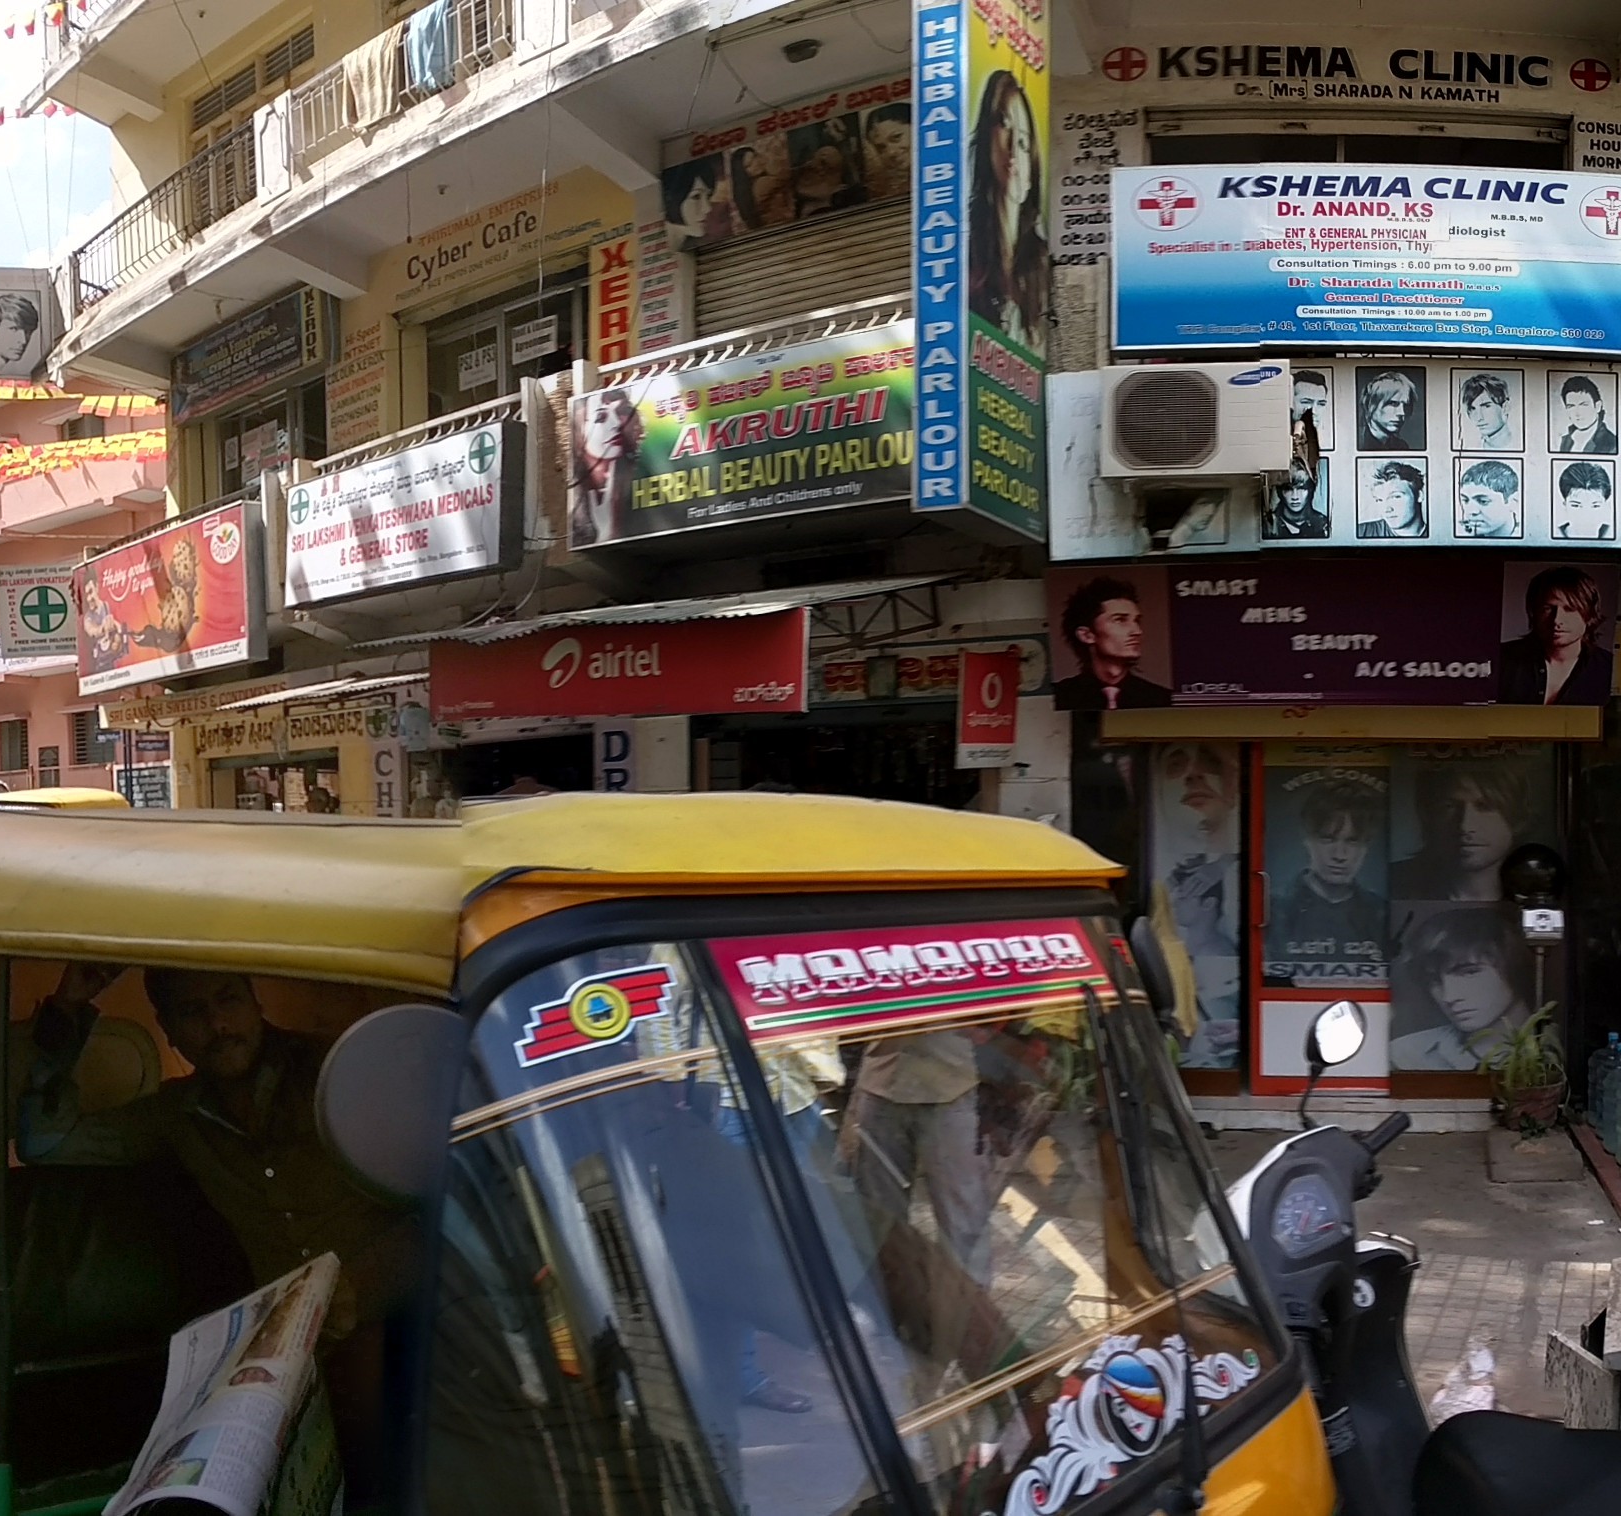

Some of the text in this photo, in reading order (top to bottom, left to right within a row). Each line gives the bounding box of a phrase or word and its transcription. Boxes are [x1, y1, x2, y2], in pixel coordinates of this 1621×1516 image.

[1159, 45, 1551, 86] KSHEMA CLINIC
[1313, 83, 1393, 100] SHARADA
[1399, 85, 1412, 99] N
[1420, 87, 1500, 104] KAMATH
[1218, 175, 1569, 204] KSHEMA CLINIC
[1277, 202, 1305, 217] Dr.
[1404, 202, 1434, 217] KS
[1285, 228, 1427, 240] ENT & GENERAL PHYSICIAN
[1311, 238, 1402, 252] Hypertension,
[407, 241, 473, 283] Cyber
[482, 209, 537, 250] Cafe
[920, 16, 957, 499] HERBAL BEAUTY PARLOUR
[1277, 259, 1513, 274] Consultation Timings 6.00 pm to 9.00 pm
[1288, 277, 1465, 290] Dr. Sharada Kamath
[1324, 293, 1465, 305] General Practitioner
[1302, 307, 1357, 316] Consultation
[1362, 308, 1395, 317] Timings
[1303, 322, 1321, 331] 1st
[1324, 322, 1358, 333] Floor,
[1436, 323, 1458, 334] Bus
[1561, 328, 1581, 338] 560
[669, 386, 890, 460] AKRUTHI
[976, 386, 1037, 440] HERBAL
[977, 424, 1036, 473] BEAUTY
[631, 466, 717, 511] HERBAL
[720, 446, 812, 495] BEAUTY
[972, 459, 1040, 512] PARLOUR
[686, 505, 709, 519] For
[709, 500, 747, 517] Ladies
[749, 497, 773, 510] And
[833, 481, 864, 498] only
[292, 483, 494, 553] SRI LAKSHMI VENKATESHWARA MEDICALS
[340, 528, 428, 566] & GENERAL STORE
[103, 564, 127, 589] Happy
[1175, 579, 1258, 597] SMART
[1241, 606, 1307, 623] MENS
[1291, 634, 1378, 651] BEAUTY
[587, 644, 661, 680] airtel
[1355, 661, 1491, 678] A/C SALOON
[166, 696, 207, 716] SWEETS
[737, 933, 1094, 1007] MAMATHA
[1269, 962, 1391, 979] SMART
